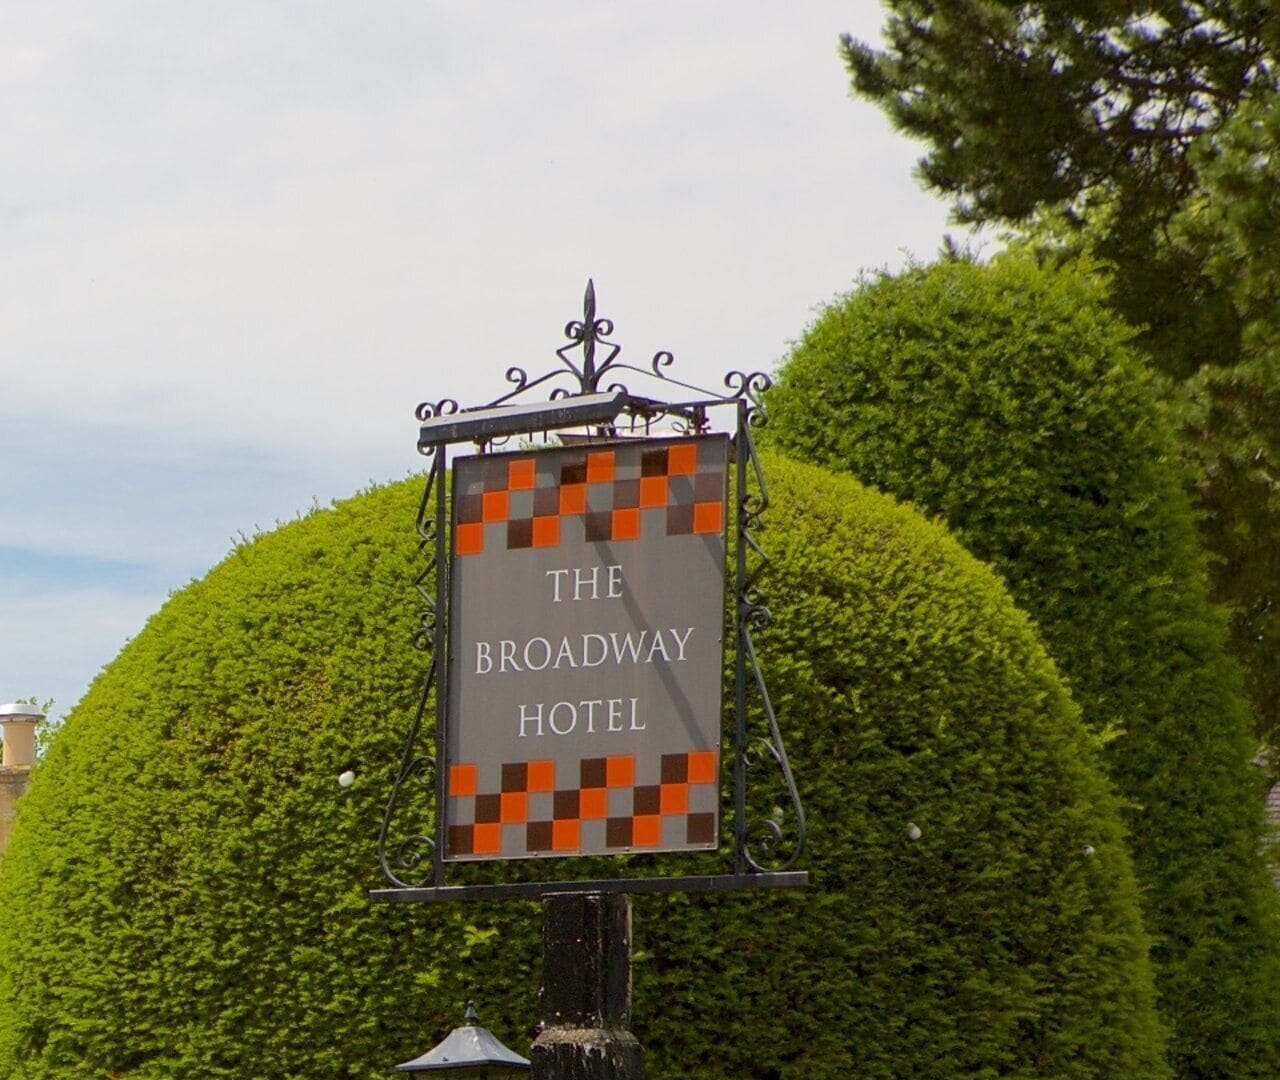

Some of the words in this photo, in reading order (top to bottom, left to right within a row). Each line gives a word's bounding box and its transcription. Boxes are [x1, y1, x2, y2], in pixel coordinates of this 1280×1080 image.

[546, 564, 623, 602] THE
[474, 627, 695, 675] BROADWAY
[517, 698, 646, 737] HOTEL
